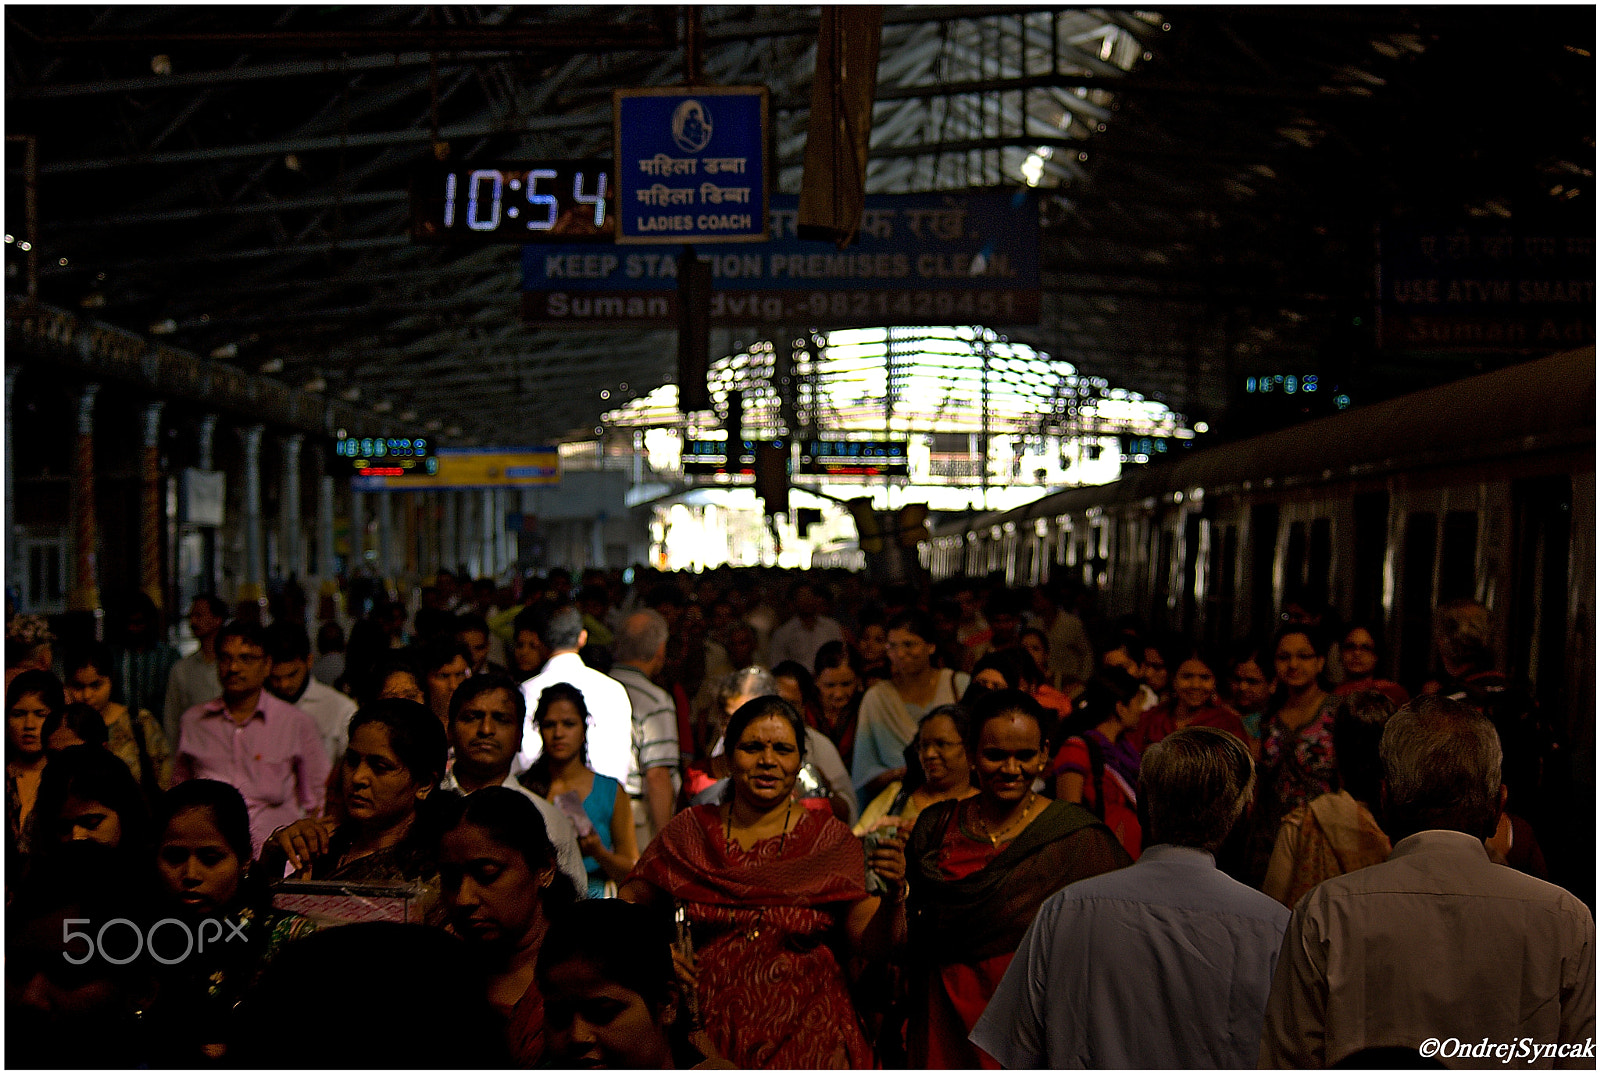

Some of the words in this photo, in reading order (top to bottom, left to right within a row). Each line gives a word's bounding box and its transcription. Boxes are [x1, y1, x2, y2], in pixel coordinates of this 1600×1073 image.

[639, 153, 698, 177] महिला
[443, 168, 608, 231] 10:54
[636, 183, 695, 207] महिला
[637, 215, 694, 231] LADIES
[697, 214, 751, 230] COACH
[545, 253, 618, 280] KEEP
[624, 252, 763, 279] STAION
[769, 252, 912, 279] PREMISES
[1393, 278, 1440, 304] USE
[1446, 278, 1512, 304] ATVM
[546, 292, 669, 317] Suman
[1406, 315, 1527, 342] Suman
